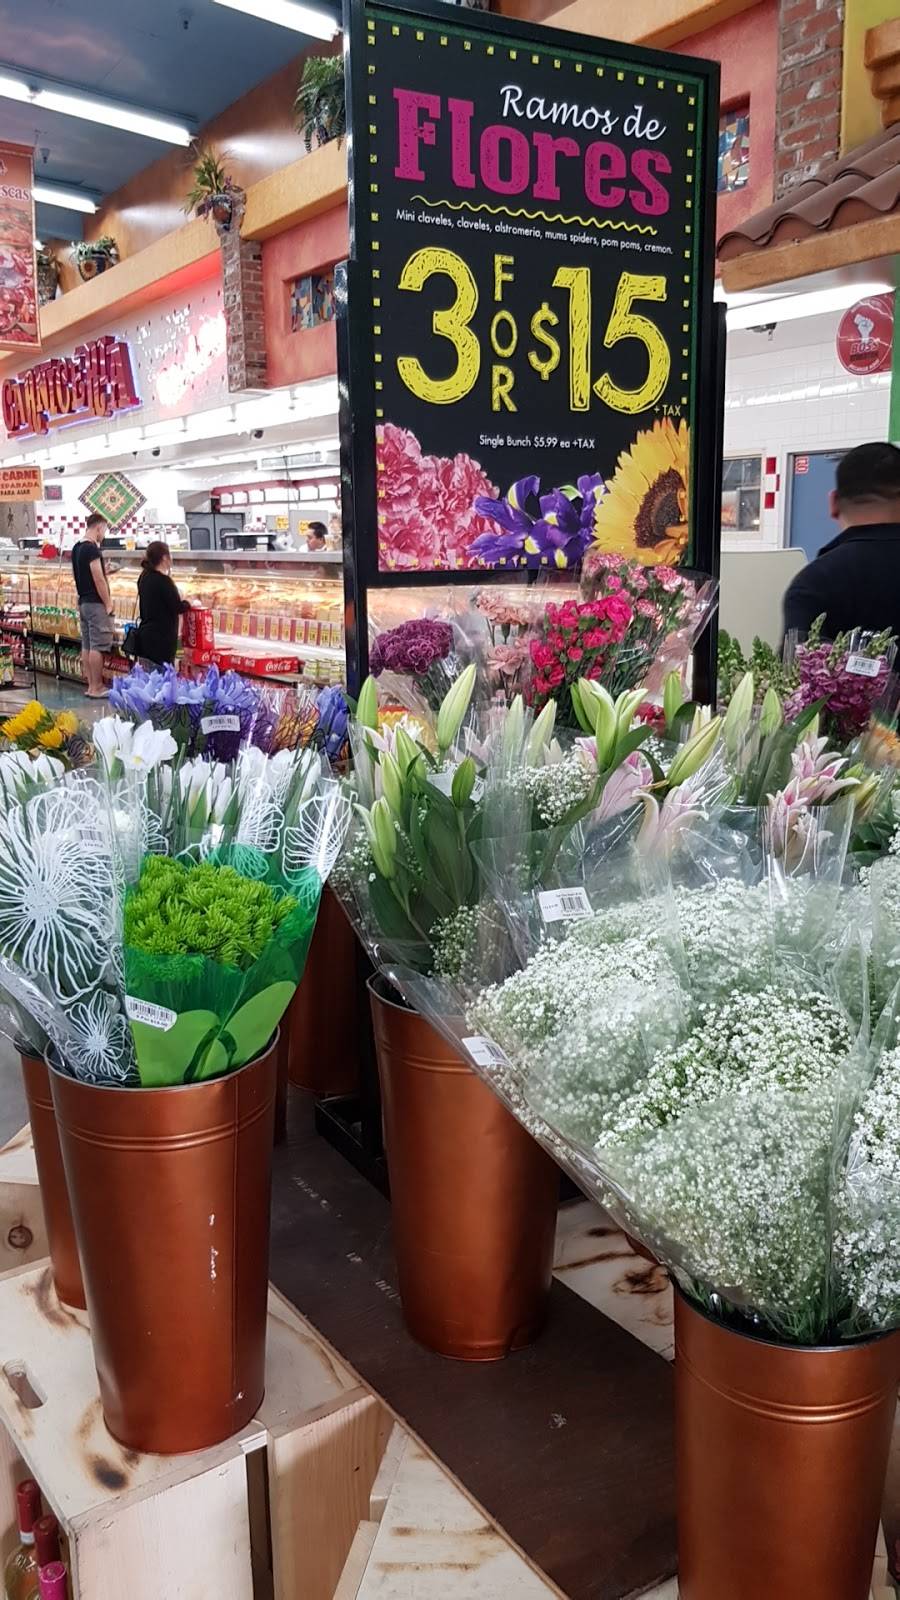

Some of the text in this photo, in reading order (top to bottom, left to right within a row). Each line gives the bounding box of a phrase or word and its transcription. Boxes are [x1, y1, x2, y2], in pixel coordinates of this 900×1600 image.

[500, 85, 667, 140] Ramos de
[392, 87, 672, 216] Flores
[396, 209, 673, 254] Mini claveles, claveles, alstromeria, mums spiders, pom poms, cremon.
[397, 246, 481, 405] 3
[479, 435, 595, 449] Single Bunch $5.99 ea +TAX
[2, 470, 38, 481] CARNE
